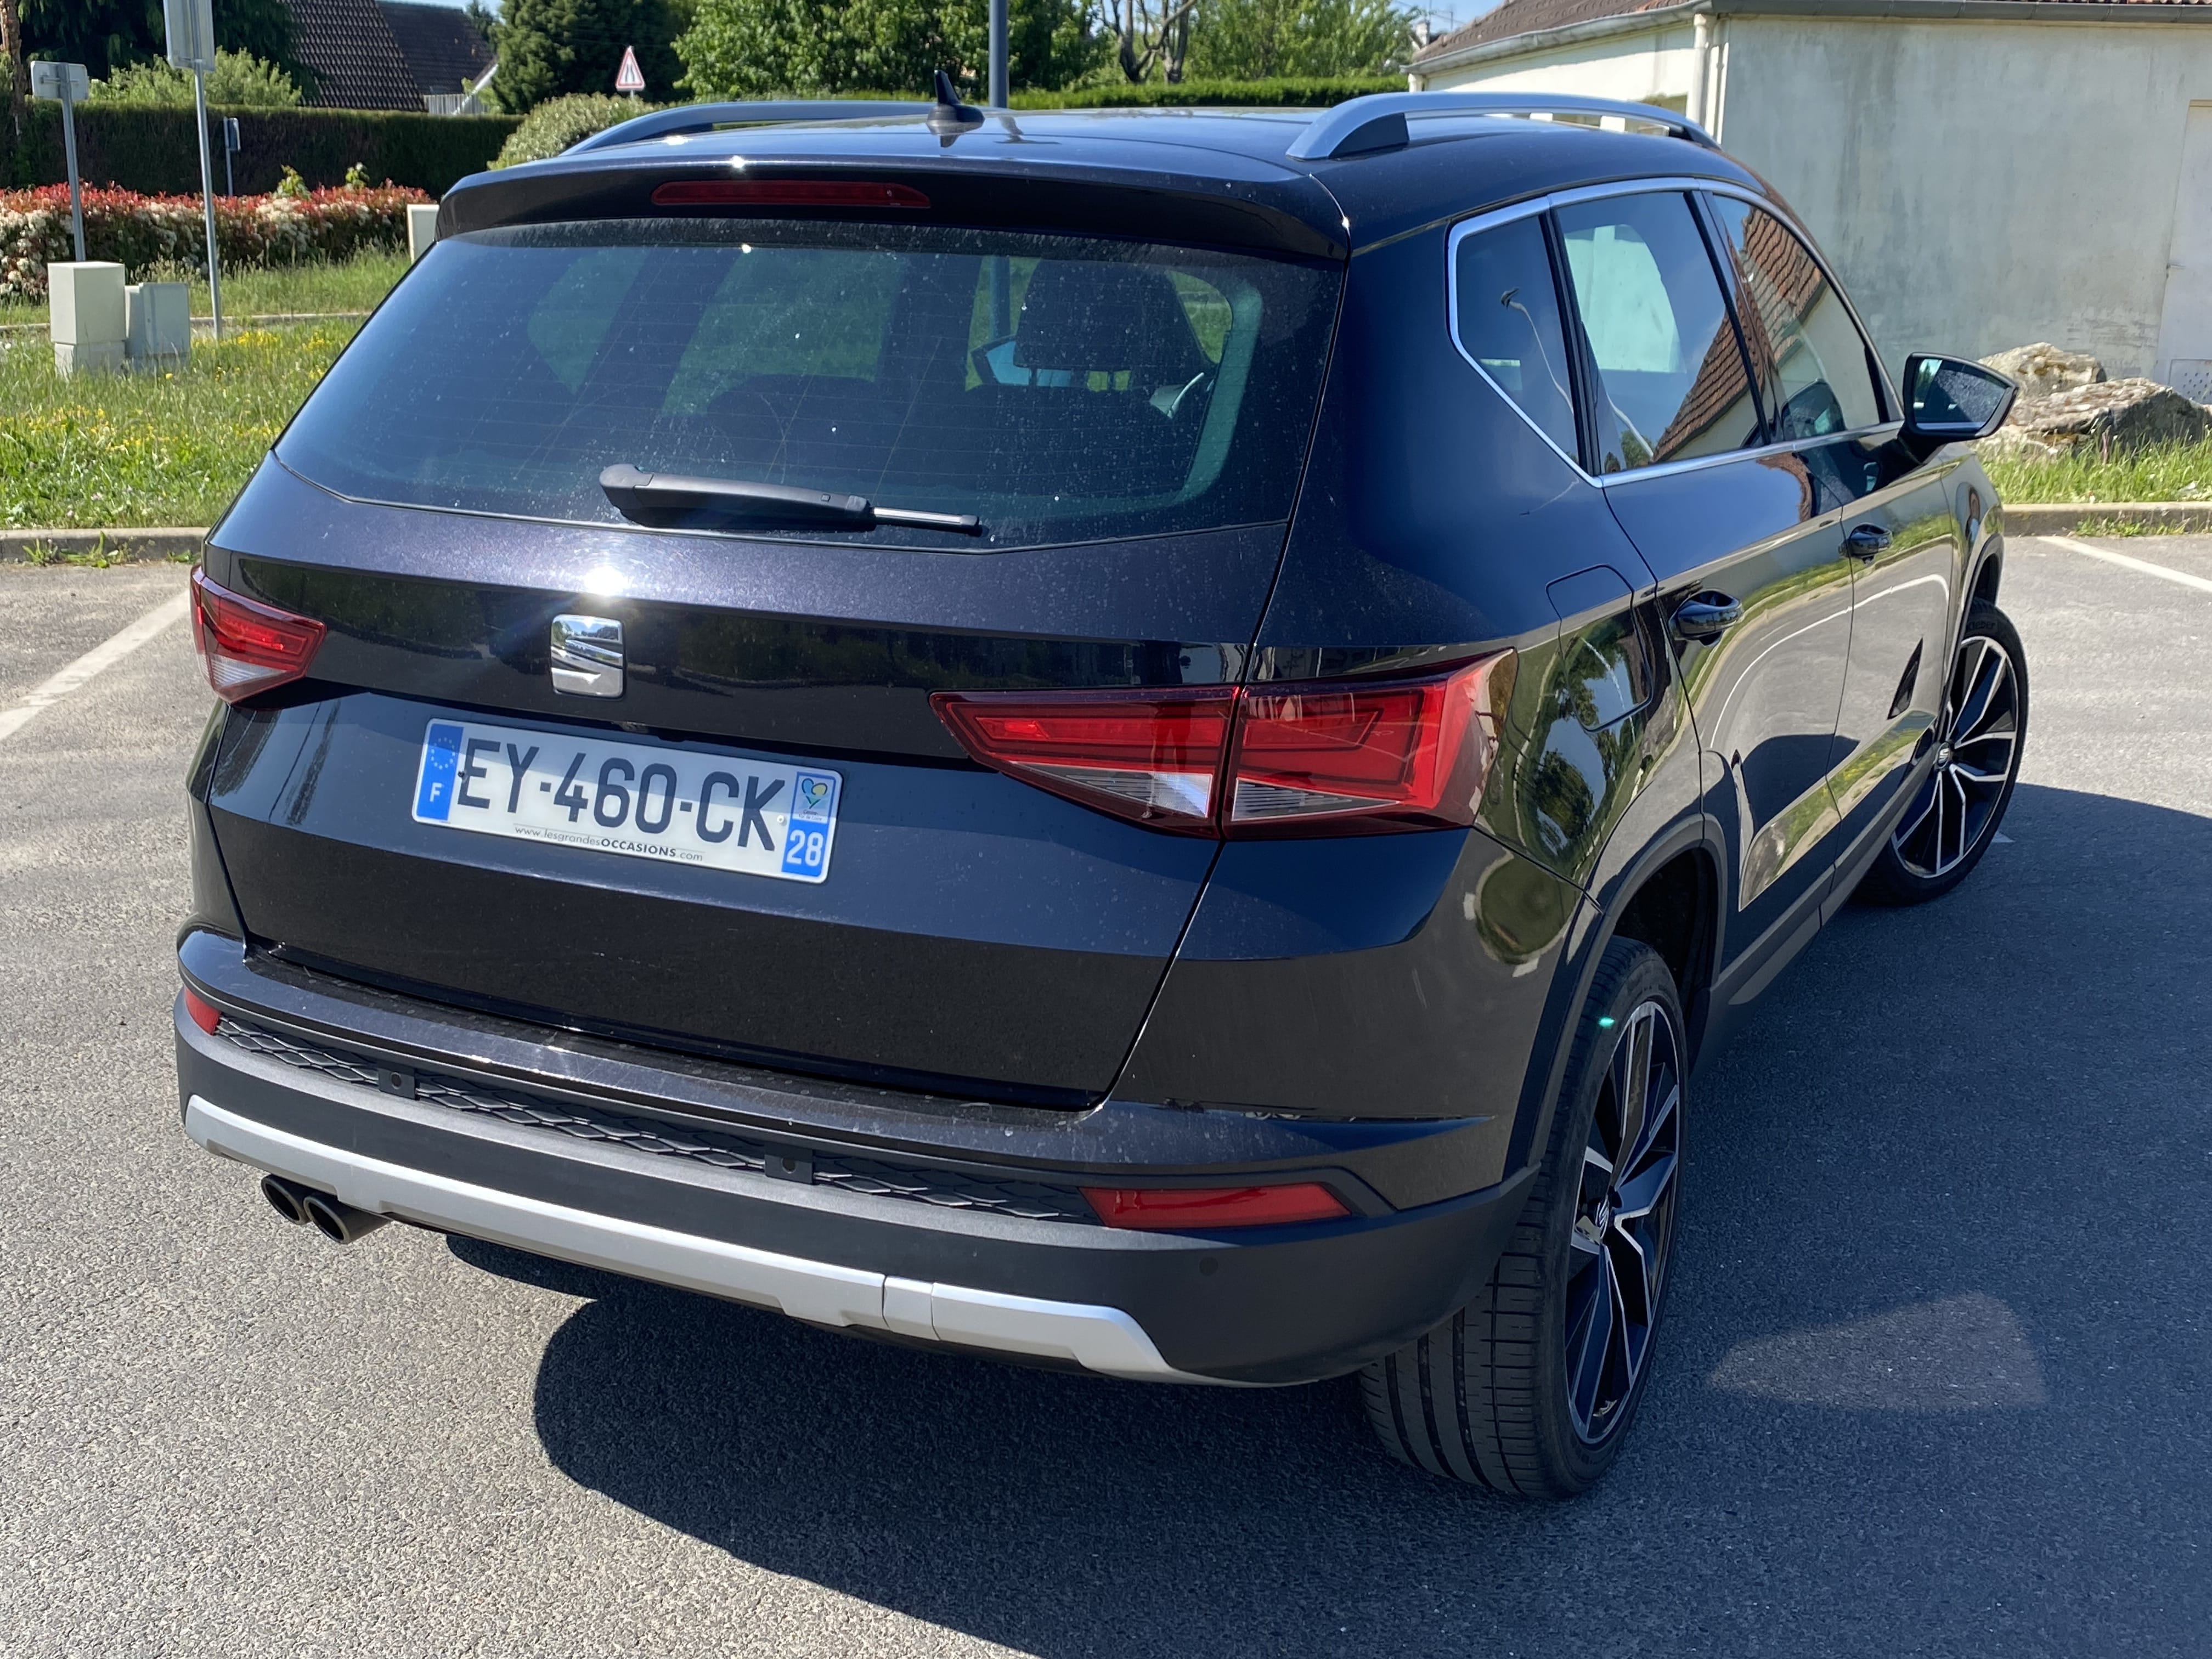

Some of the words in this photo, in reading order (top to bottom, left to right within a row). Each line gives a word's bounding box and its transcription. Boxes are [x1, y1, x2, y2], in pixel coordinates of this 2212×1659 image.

[430, 782, 442, 802] F
[458, 738, 785, 851] EY-460-CK
[786, 830, 823, 866] 28
